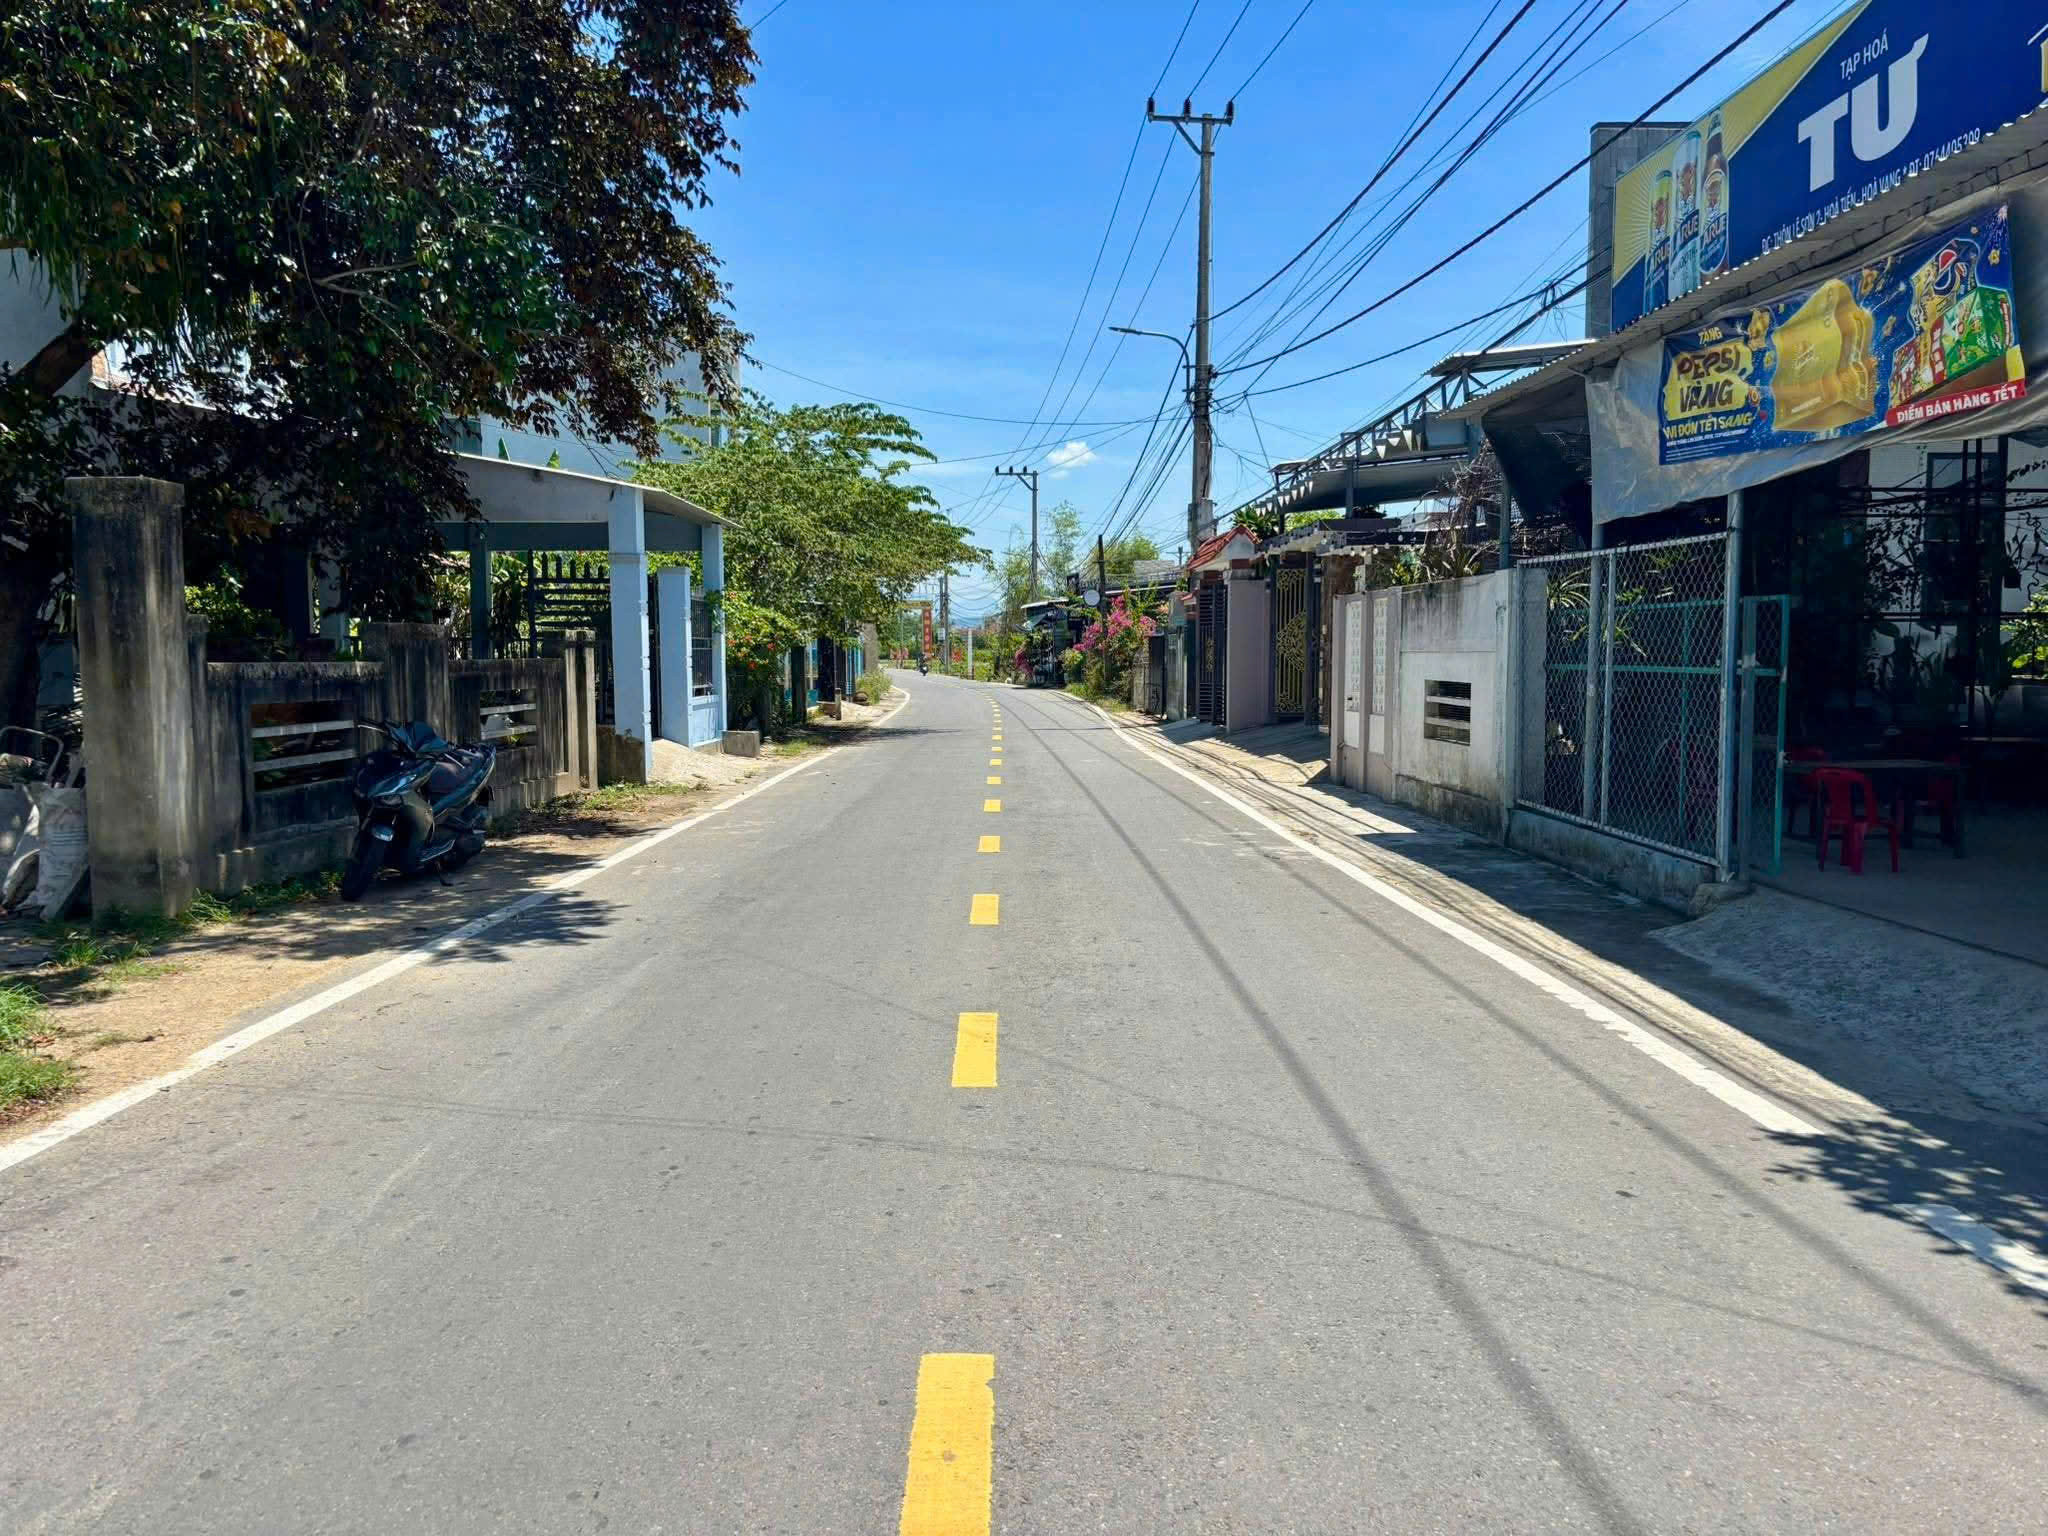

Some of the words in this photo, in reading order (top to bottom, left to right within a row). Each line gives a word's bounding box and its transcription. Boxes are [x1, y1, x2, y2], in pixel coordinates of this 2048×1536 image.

[1840, 52, 1861, 81] TẠP
[1863, 28, 1889, 65] HOÁ
[1797, 33, 1929, 192] TƯ
[1676, 344, 1740, 381] PEPSI
[1680, 378, 1734, 413] VÀNG
[1896, 404, 1924, 423] ĐIỂM
[1925, 400, 1951, 417] BÁN
[1953, 392, 1991, 412] HÀNG
[1993, 384, 2018, 403] TẾT
